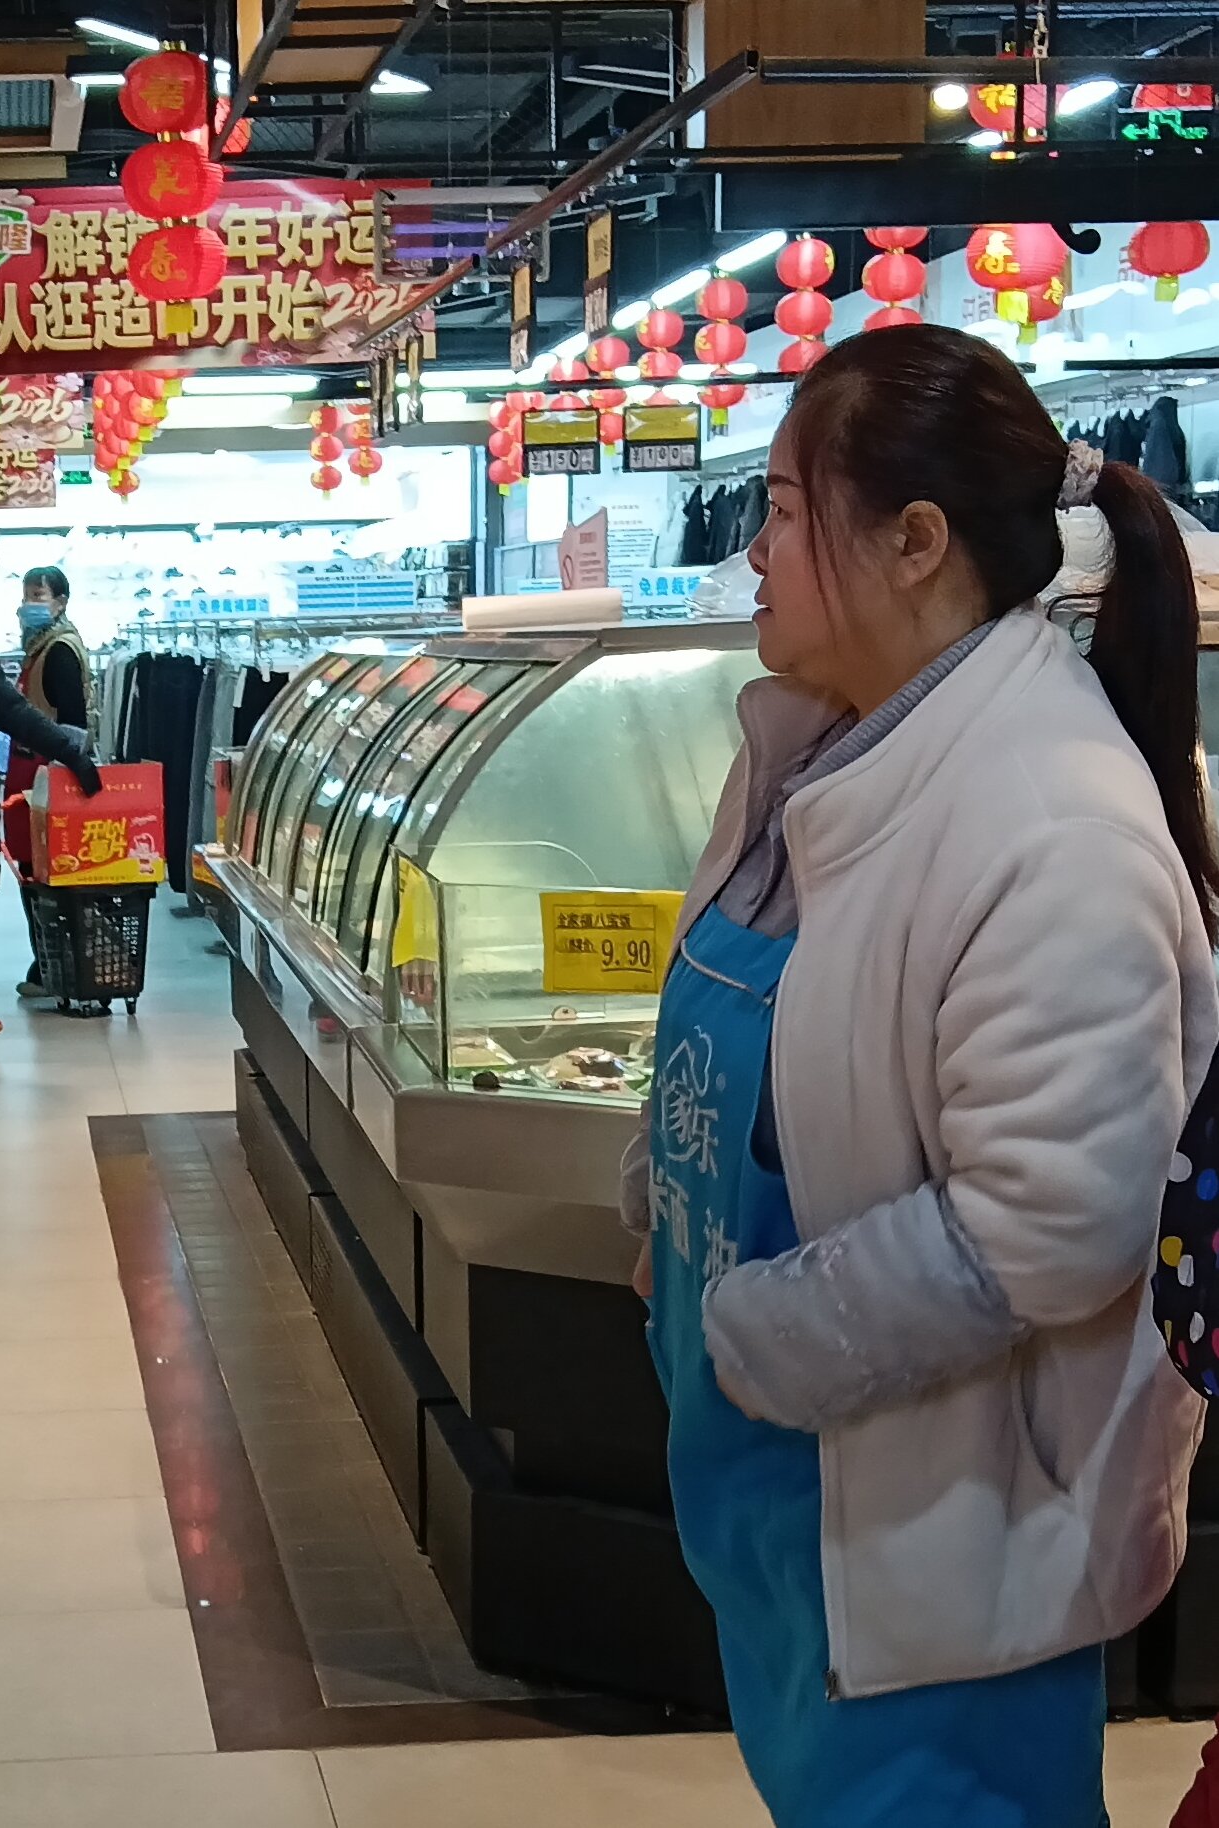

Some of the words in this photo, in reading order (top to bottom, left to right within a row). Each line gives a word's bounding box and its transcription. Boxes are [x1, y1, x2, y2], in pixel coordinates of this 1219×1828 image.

[36, 200, 388, 279] 解锁年好运
[321, 280, 414, 328] 202
[601, 938, 651, 967] 9.90
